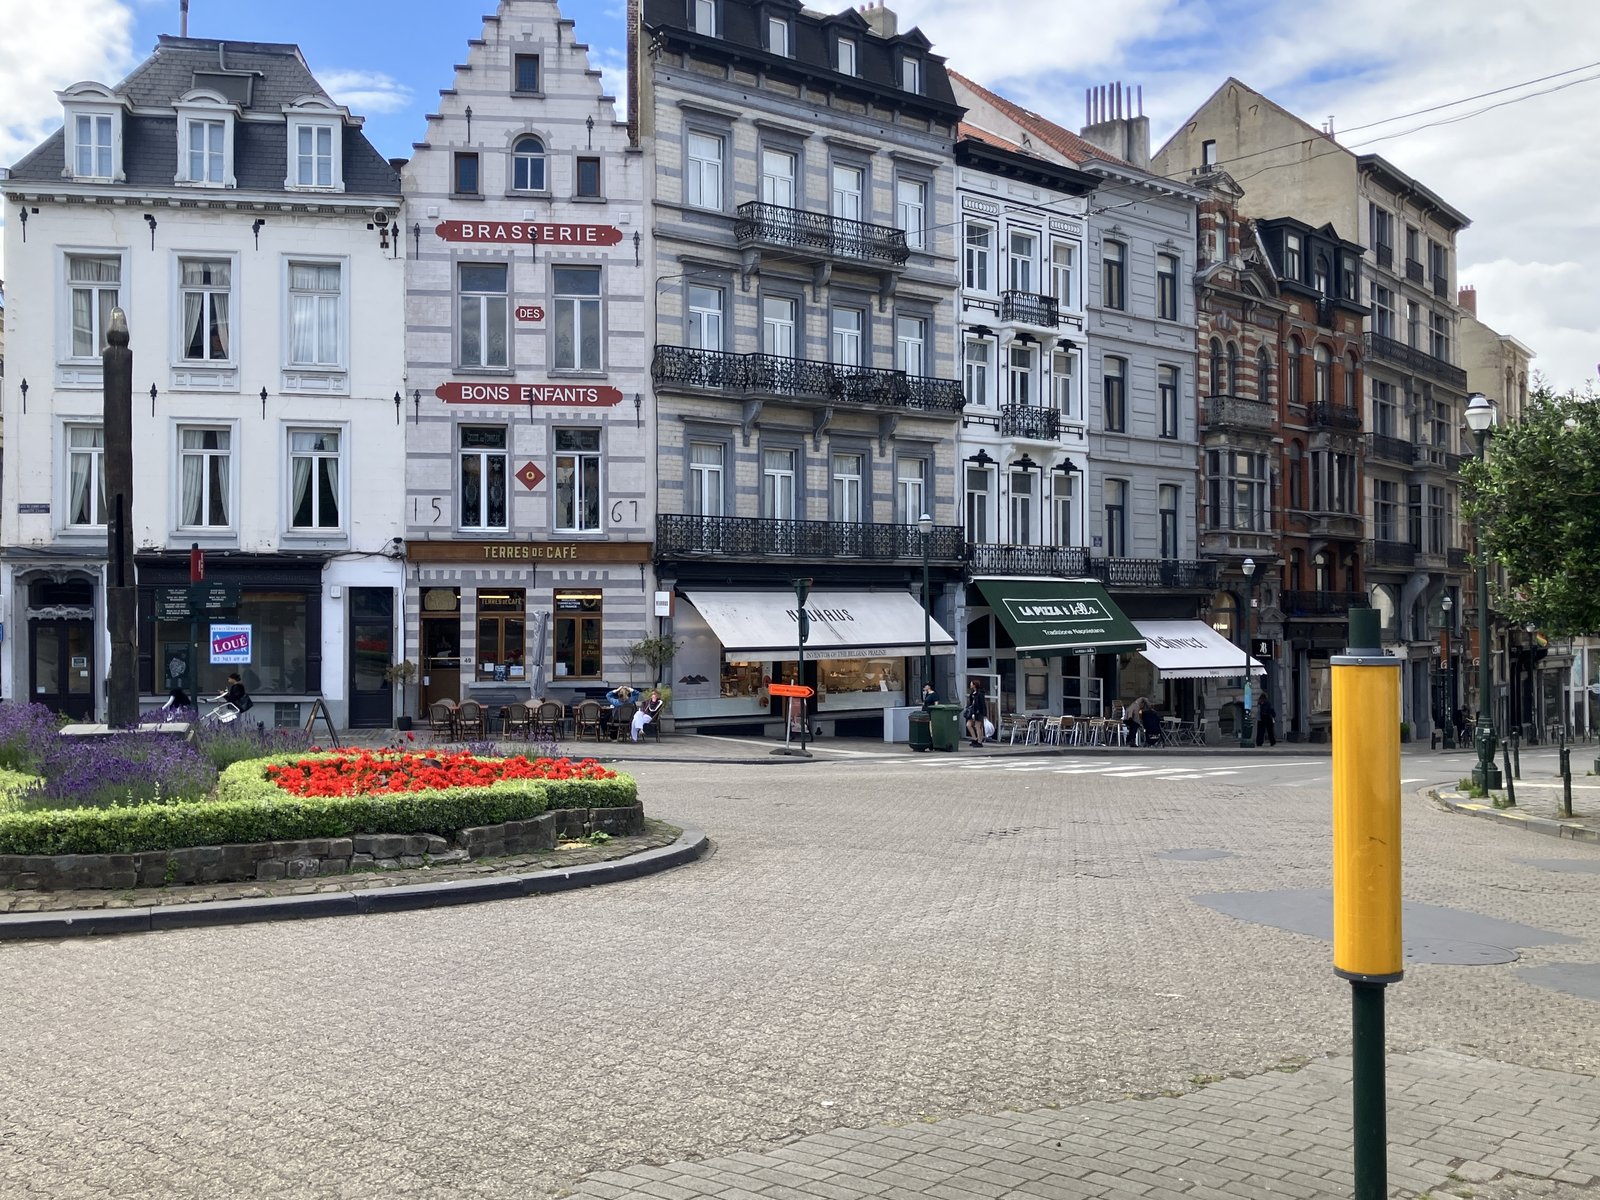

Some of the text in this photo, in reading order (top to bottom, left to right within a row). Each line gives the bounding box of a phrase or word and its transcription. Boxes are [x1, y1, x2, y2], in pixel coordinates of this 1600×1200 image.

[462, 224, 597, 242] BRASSERIE
[520, 308, 540, 319] DES
[461, 386, 598, 403] BONS ENFANTS
[484, 543, 577, 558] TERRES DE CAFÉ
[786, 609, 855, 622] NUHAUS
[1018, 606, 1035, 616] LA
[1032, 606, 1064, 616] PIZZA
[213, 634, 248, 653] LOUÉ
